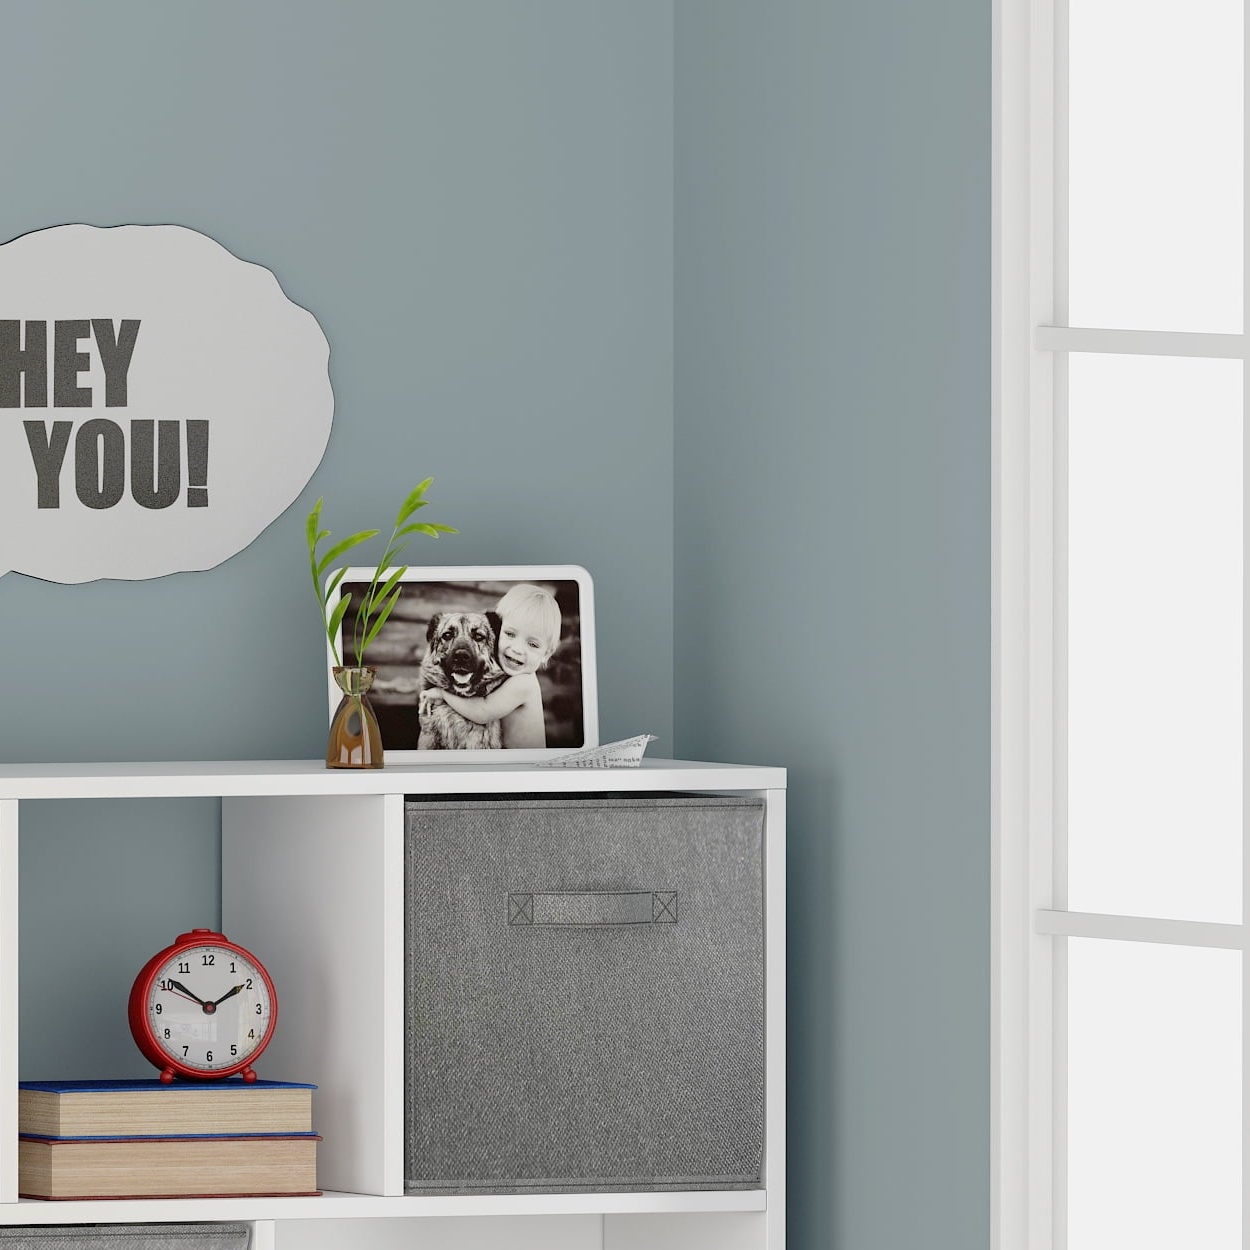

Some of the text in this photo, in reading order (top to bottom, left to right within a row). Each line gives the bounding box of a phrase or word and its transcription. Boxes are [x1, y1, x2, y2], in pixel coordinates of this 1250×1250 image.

[22, 418, 209, 510] YOU!
[202, 955, 215, 966] 12
[178, 963, 190, 974] 11
[230, 962, 237, 973] 1
[160, 979, 174, 991] 10
[245, 978, 253, 990] 2
[155, 1004, 163, 1015] 9
[255, 1004, 262, 1015] 3
[164, 1029, 171, 1039] 8
[247, 1028, 255, 1039] 4
[182, 1045, 189, 1057] 7
[230, 1044, 237, 1056] 5
[206, 1051, 213, 1062] 6
